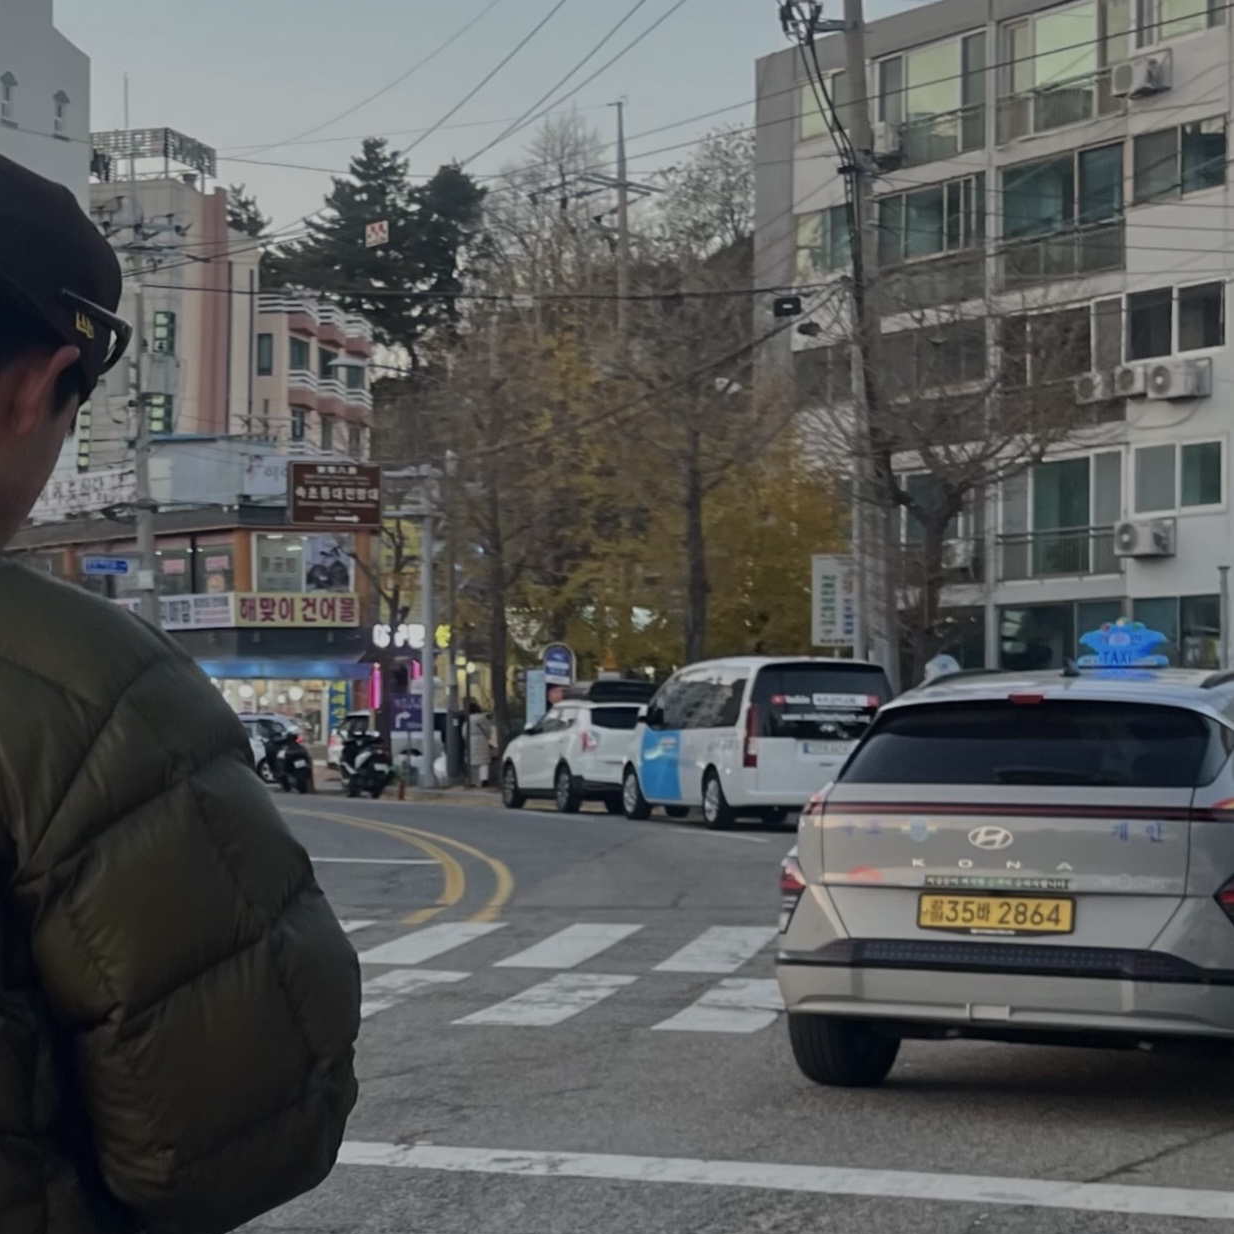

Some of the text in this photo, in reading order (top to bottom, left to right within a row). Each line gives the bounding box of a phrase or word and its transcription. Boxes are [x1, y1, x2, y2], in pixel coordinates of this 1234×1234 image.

[239, 596, 295, 623] 해맞이
[300, 596, 356, 623] 건어물
[912, 858, 1073, 871] KONA
[997, 901, 1062, 927] 2864
